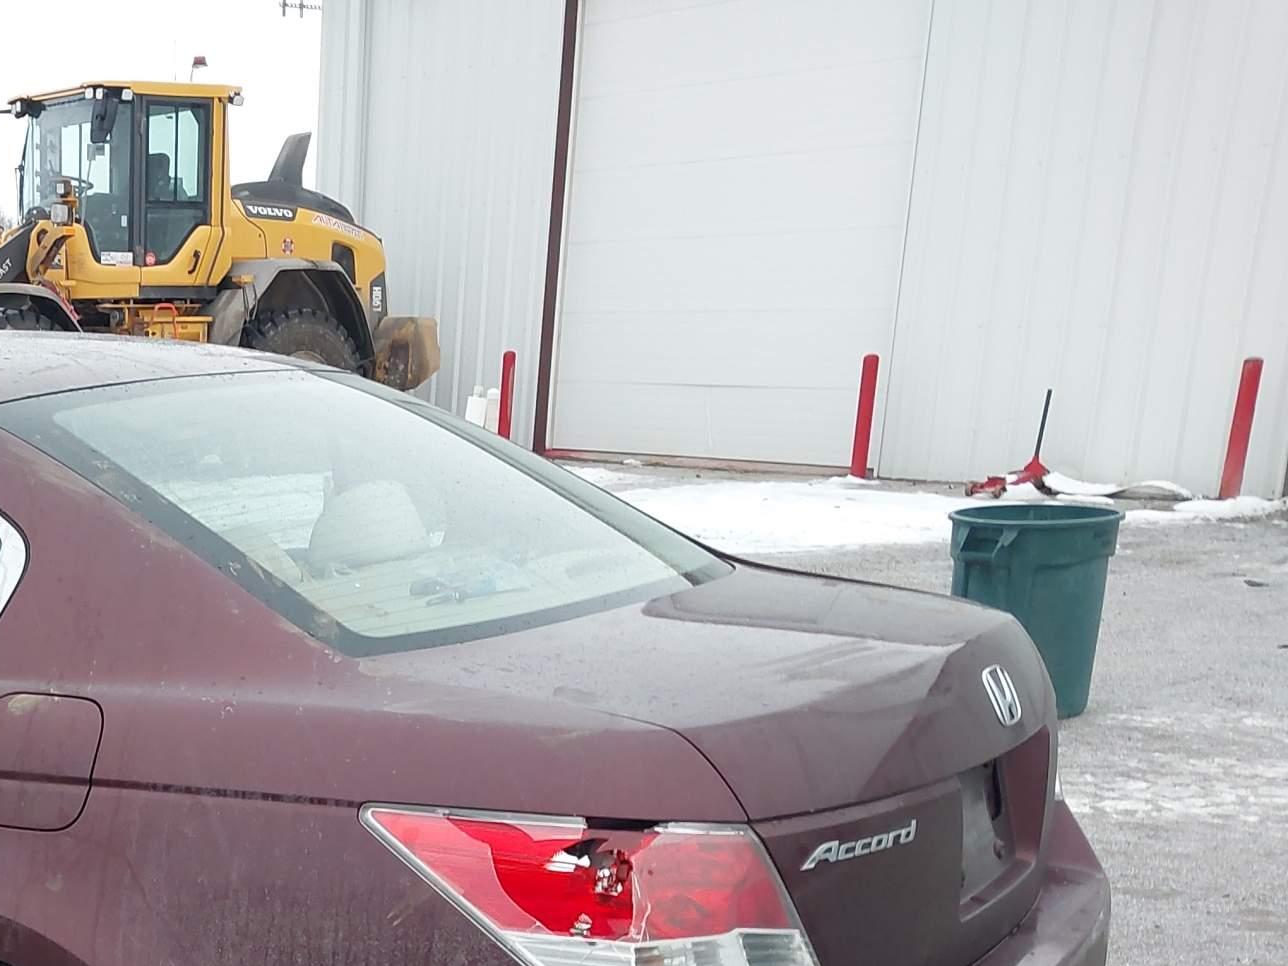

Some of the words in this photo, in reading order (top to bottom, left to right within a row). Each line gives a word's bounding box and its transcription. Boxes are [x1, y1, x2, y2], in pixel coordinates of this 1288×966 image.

[245, 205, 294, 218] VOLVO
[372, 286, 382, 312] L90H
[799, 818, 918, 871] Accord
